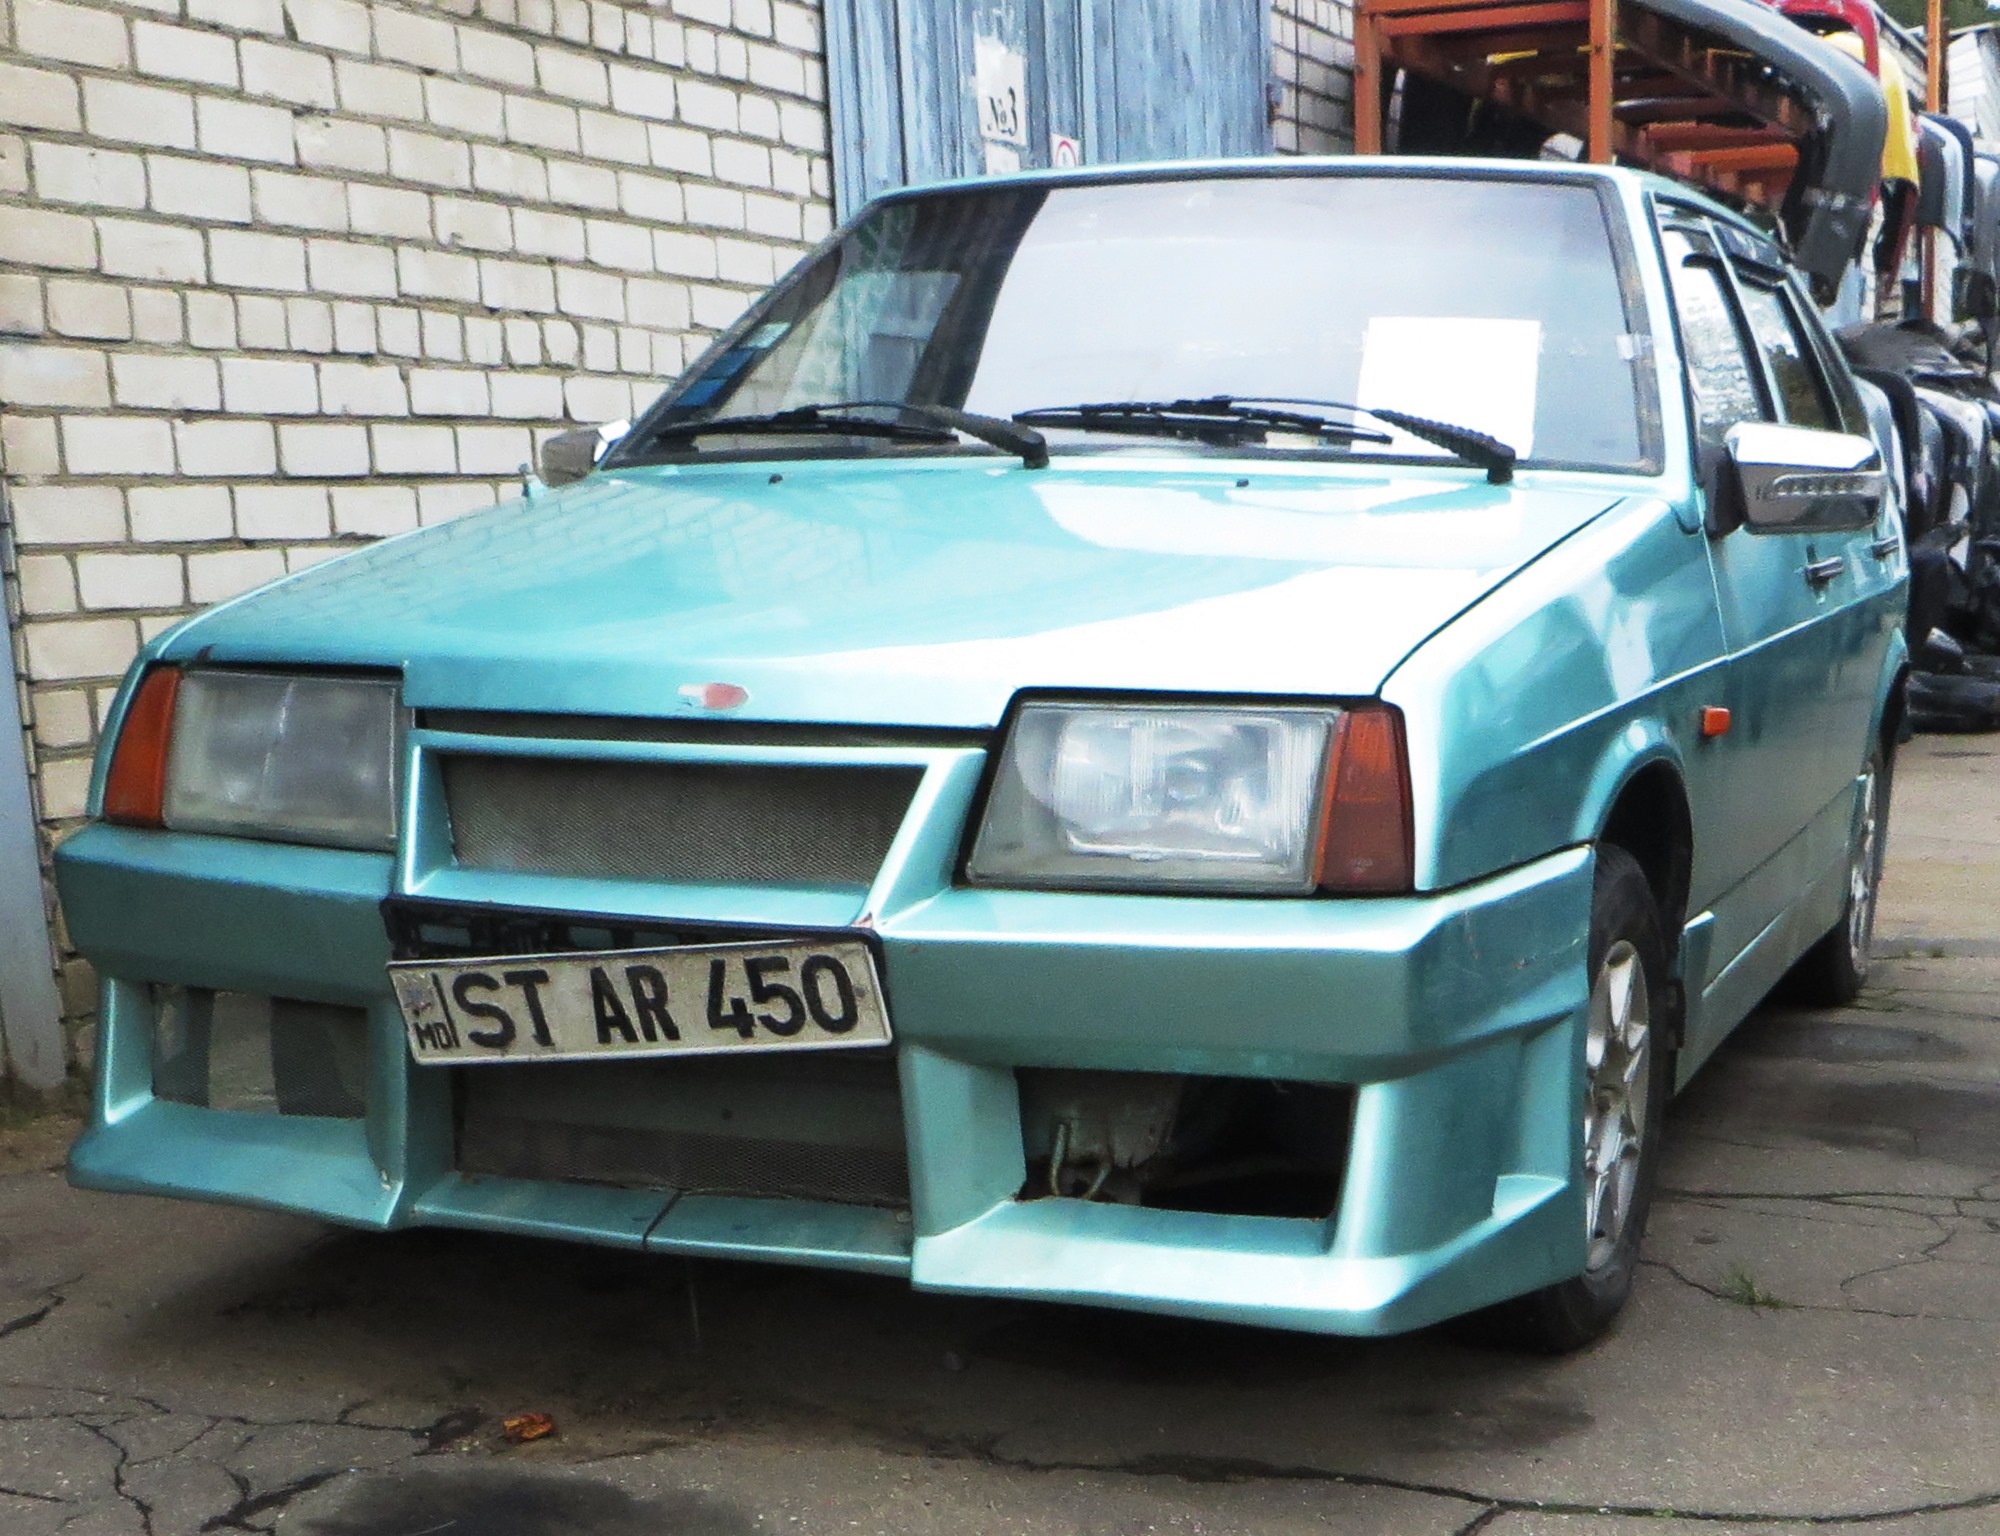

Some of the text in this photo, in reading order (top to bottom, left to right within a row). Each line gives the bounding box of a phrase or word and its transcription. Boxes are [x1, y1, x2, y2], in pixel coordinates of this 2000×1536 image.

[451, 954, 860, 1048] ST AR 450
